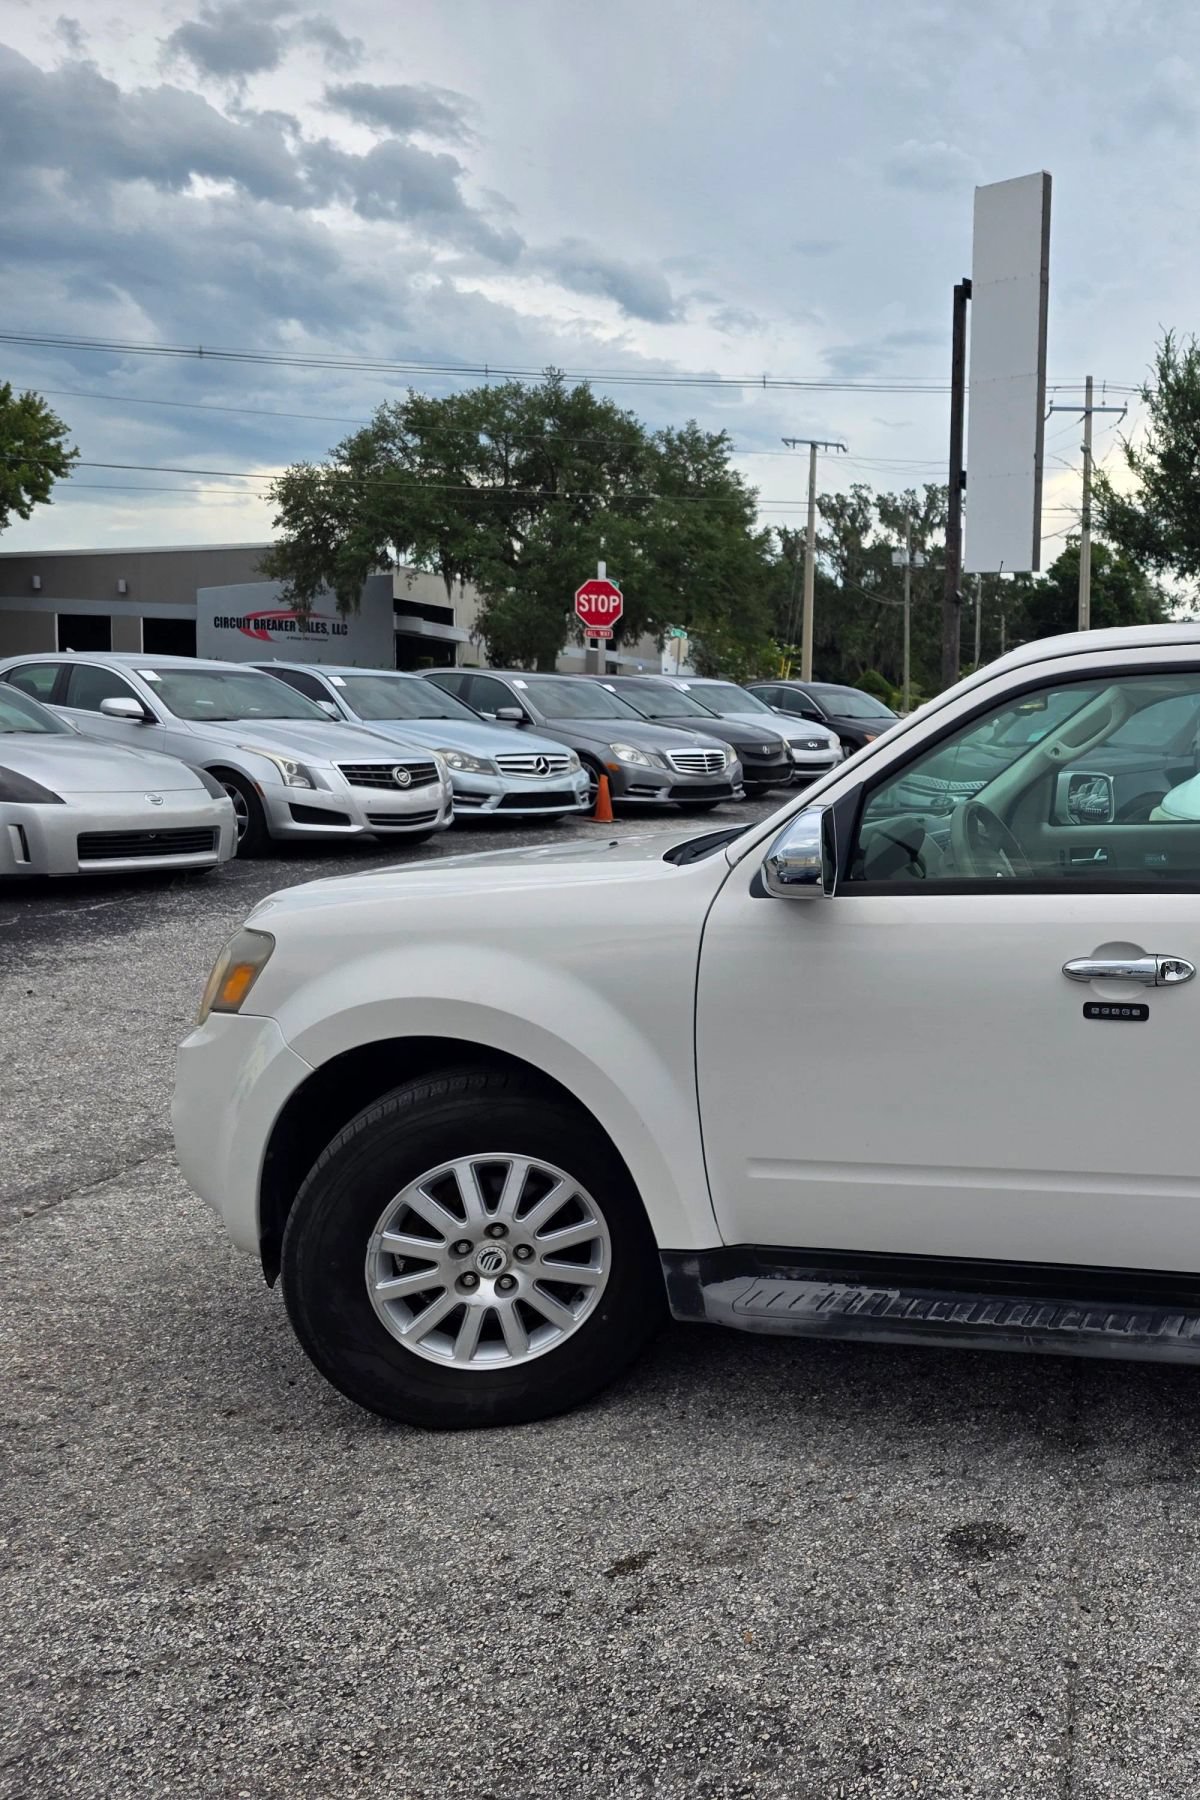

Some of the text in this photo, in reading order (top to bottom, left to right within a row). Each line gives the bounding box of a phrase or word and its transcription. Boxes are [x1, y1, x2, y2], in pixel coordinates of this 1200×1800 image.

[579, 594, 619, 612] STOP
[213, 616, 251, 629] CIRCUIT
[253, 618, 296, 632] BREAKER
[331, 623, 348, 636] LLC
